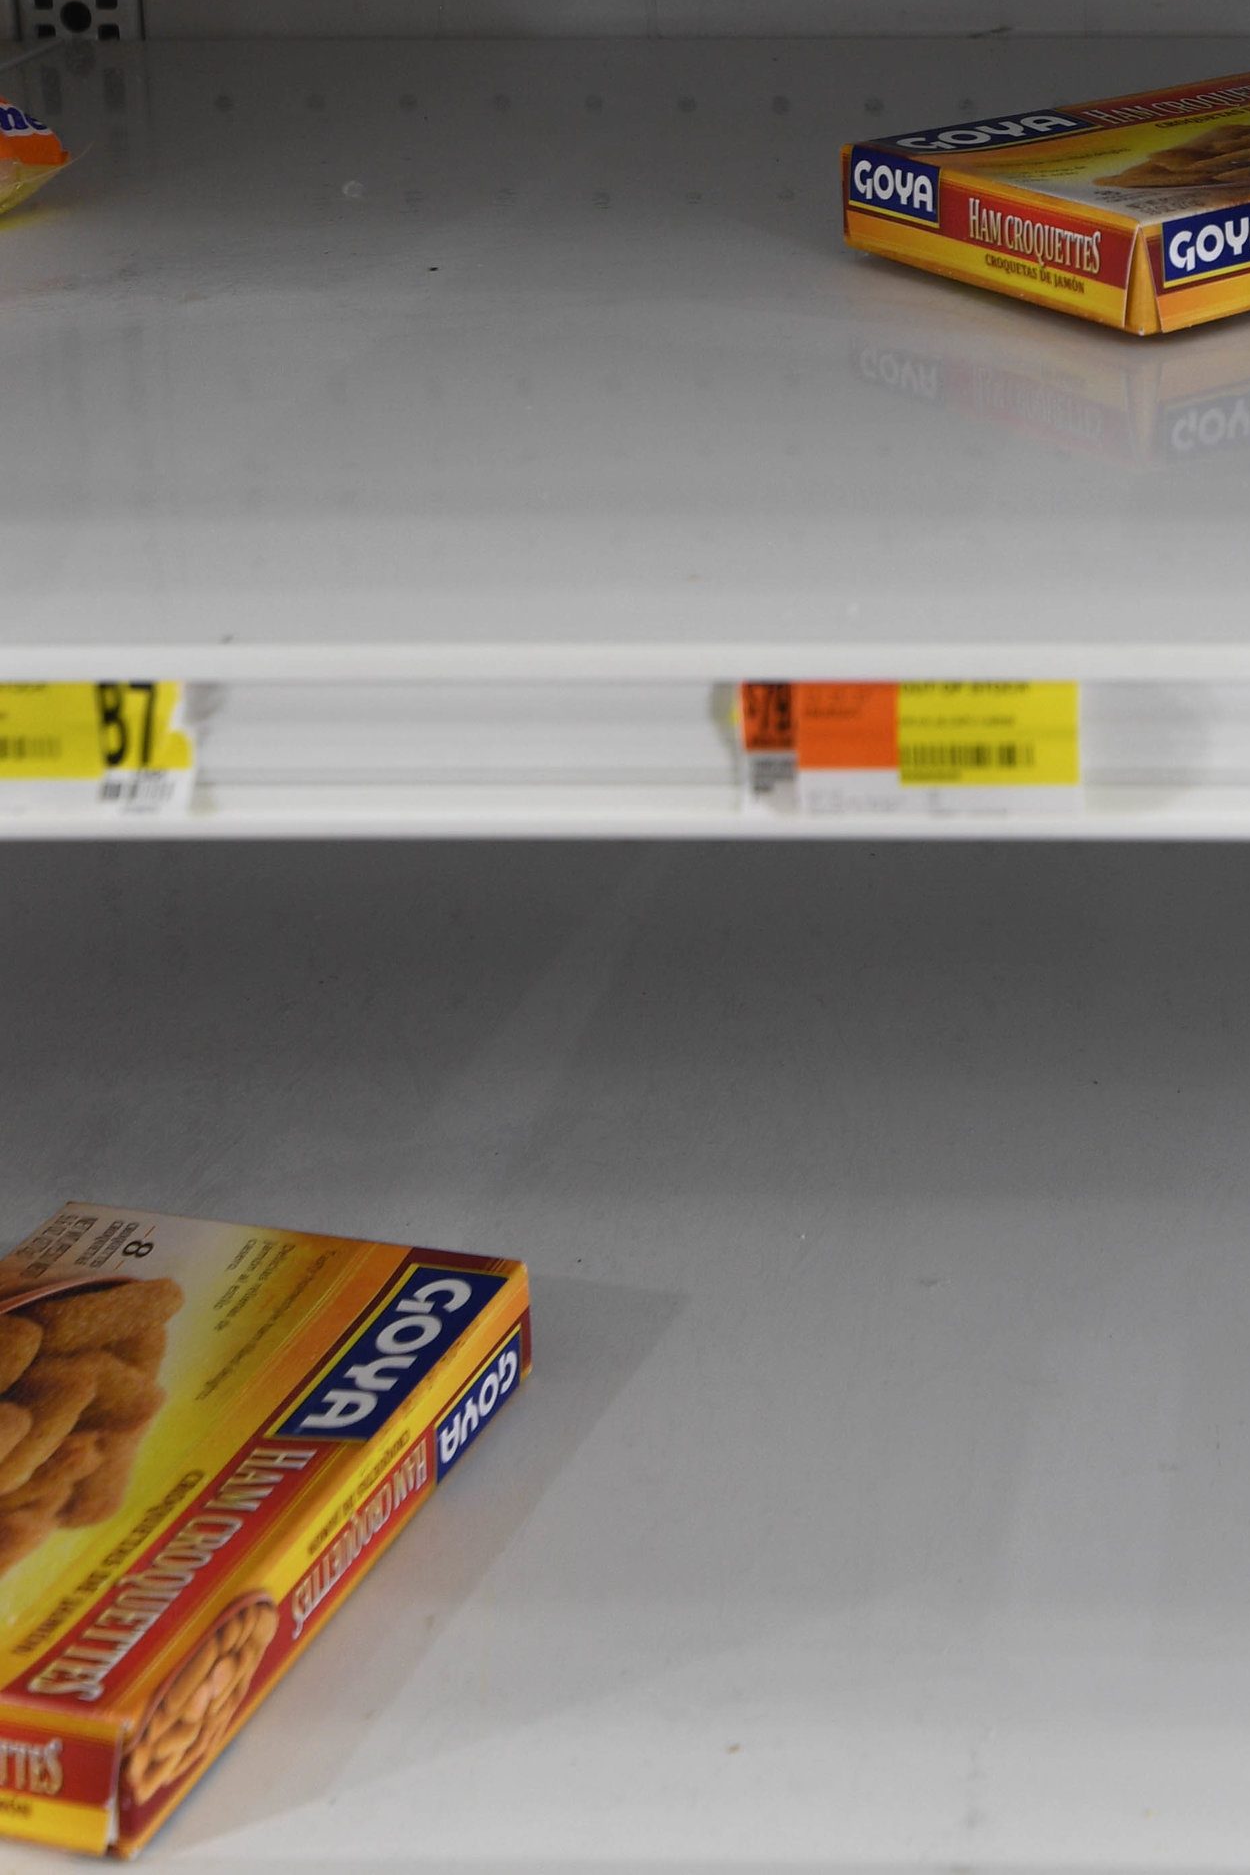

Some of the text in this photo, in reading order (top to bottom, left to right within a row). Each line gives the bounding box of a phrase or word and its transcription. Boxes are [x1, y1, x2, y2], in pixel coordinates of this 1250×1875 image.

[895, 115, 1079, 150] GOYA
[1082, 105, 1155, 125] HAM
[854, 159, 933, 212] GOYA
[968, 198, 1102, 275] HAM CROQUETTES
[985, 252, 1085, 294] CROQUETAS DE JAMÓN
[121, 1239, 154, 1259] 8
[299, 1278, 472, 1430] GOYA
[440, 1349, 518, 1465] GOYA
[102, 1468, 206, 1567] CROQUETAS
[291, 1436, 428, 1642] HAM CROQUETTES
[27, 1447, 318, 1702] HAM CROQUETTES
